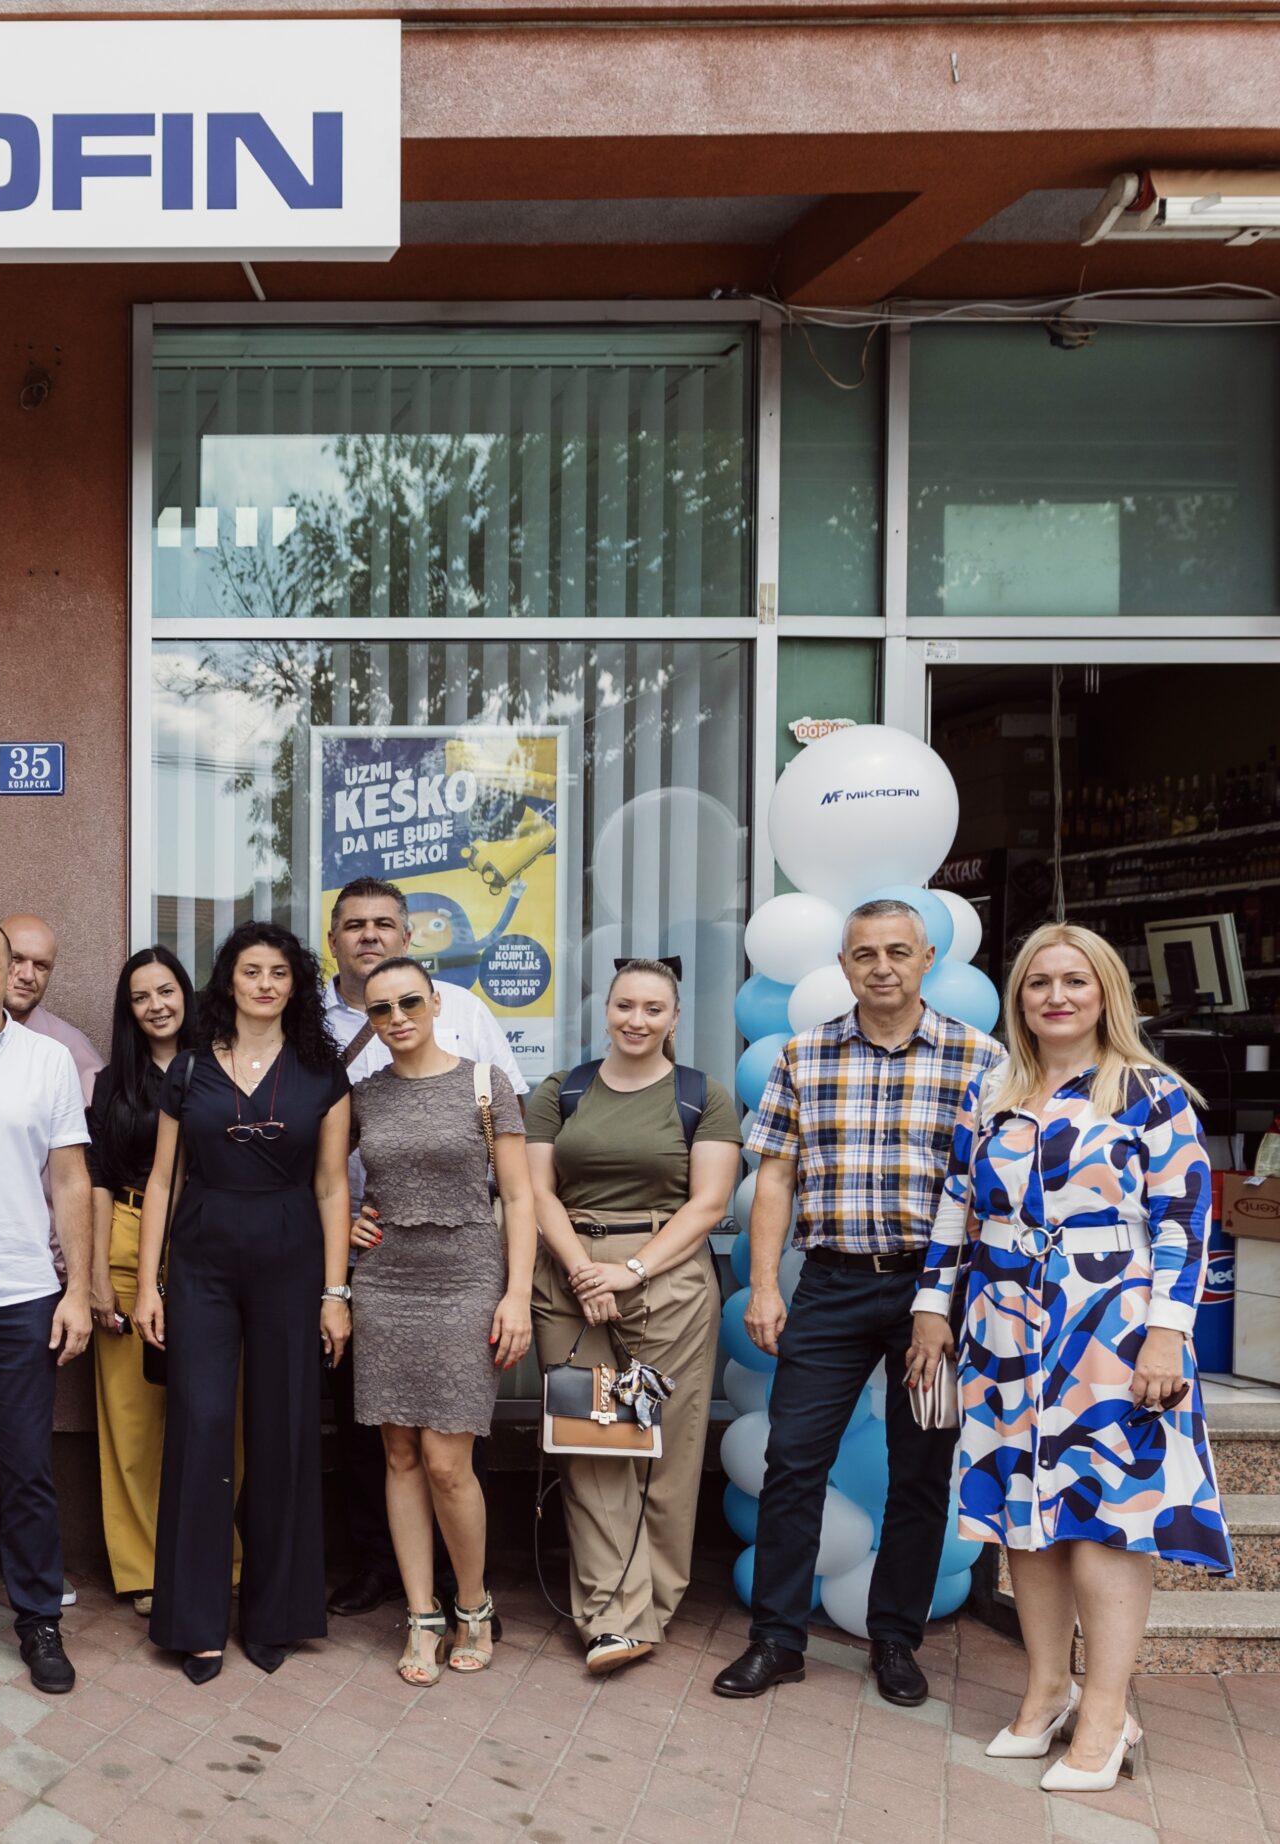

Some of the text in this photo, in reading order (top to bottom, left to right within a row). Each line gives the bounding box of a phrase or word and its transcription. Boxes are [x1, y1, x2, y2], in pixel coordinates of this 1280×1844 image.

[9, 747, 51, 780] 35
[345, 761, 392, 786] UZMI
[8, 780, 51, 789] КОЗАРСКА
[335, 768, 477, 833] KEŠKO
[821, 789, 920, 805] MF MIKROFIN
[342, 819, 454, 855] DA NE BUDE
[381, 843, 448, 871] TEŠKO!
[495, 951, 535, 960] KOJIM TI
[488, 958, 541, 971] UPRAVLJAŠ
[488, 979, 541, 987] OD 300 KM DO
[493, 987, 536, 996] 3.000 KM
